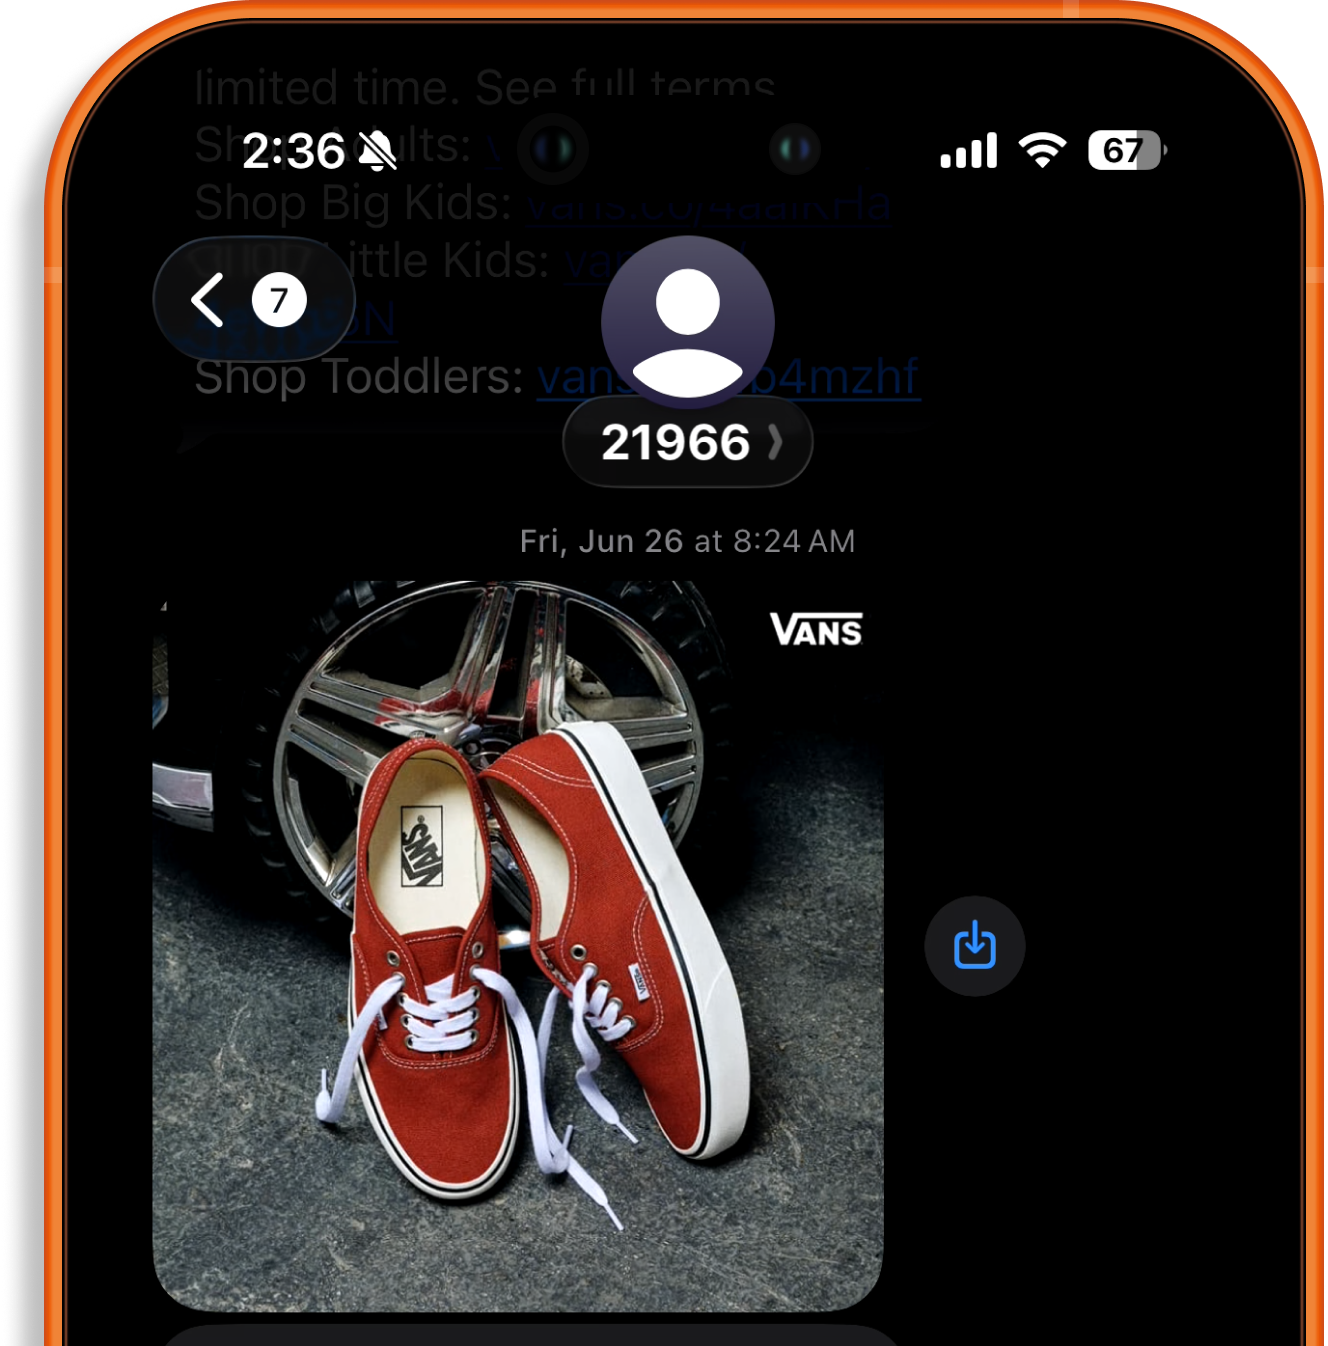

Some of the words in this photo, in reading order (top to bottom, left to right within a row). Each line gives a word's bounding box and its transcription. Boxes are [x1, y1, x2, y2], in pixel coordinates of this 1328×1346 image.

[197, 68, 336, 105] limited
[354, 68, 458, 105] time.
[477, 69, 556, 106] See
[243, 131, 345, 170] 2:36
[1102, 136, 1144, 164] 67
[196, 183, 305, 230] Shop
[324, 182, 388, 229] Big
[407, 182, 510, 220] Kids:
[325, 240, 428, 278] ittle
[445, 240, 548, 278] Kids:
[270, 288, 288, 313] 7
[196, 358, 305, 403] Shop
[322, 357, 522, 396] Toddlers:
[603, 424, 750, 461] 21966
[522, 528, 566, 558] Fri,
[579, 529, 633, 553] Jun
[646, 529, 683, 553] 26
[696, 531, 723, 553] at
[734, 529, 801, 553] 8:24
[809, 530, 854, 553] AM
[769, 612, 864, 646] VANS
